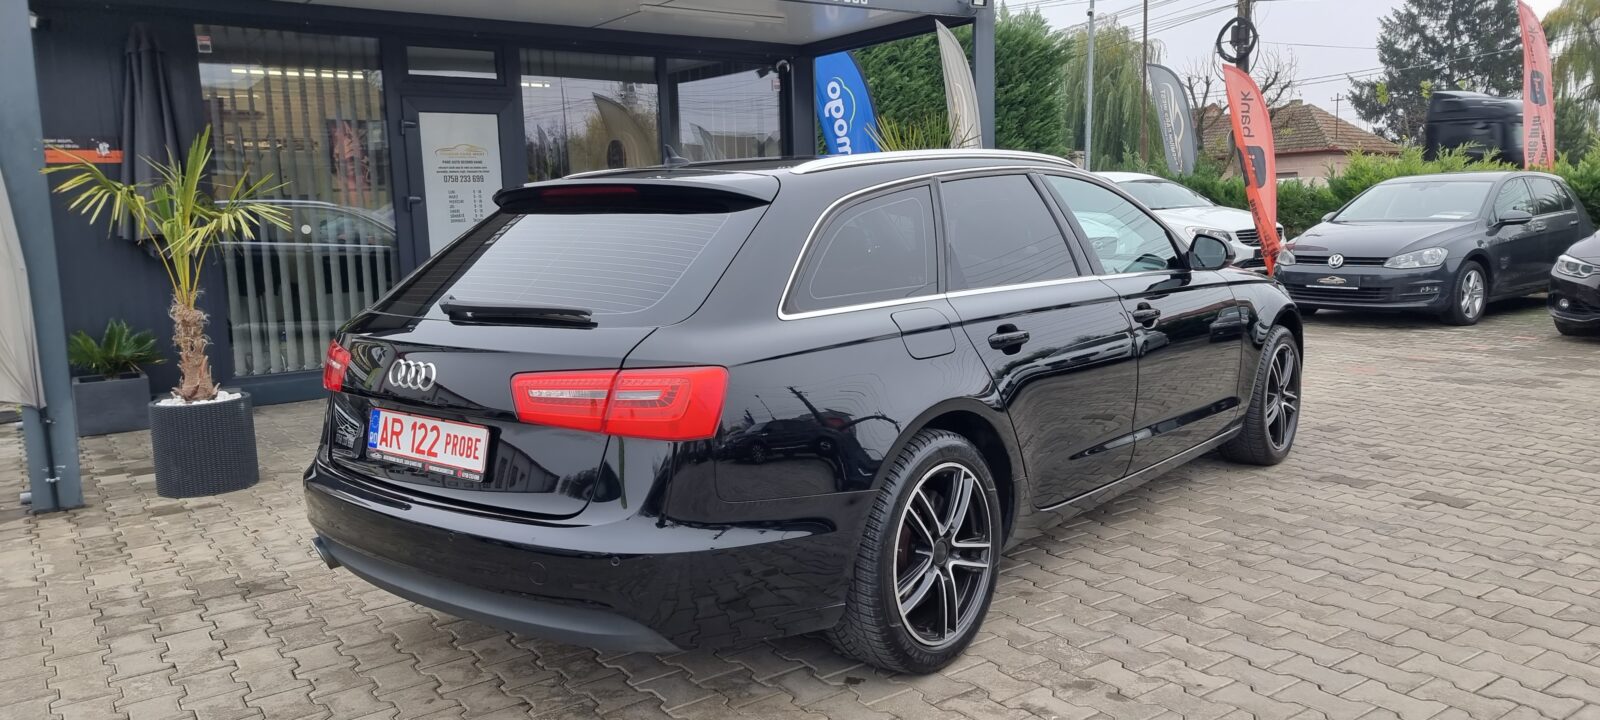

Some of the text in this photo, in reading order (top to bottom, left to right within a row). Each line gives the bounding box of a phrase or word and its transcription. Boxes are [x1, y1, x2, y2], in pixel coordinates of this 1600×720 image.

[443, 175, 485, 183] 0758 233 699
[379, 416, 404, 450] AR
[410, 421, 441, 458] 122
[444, 432, 481, 460] PROBE
